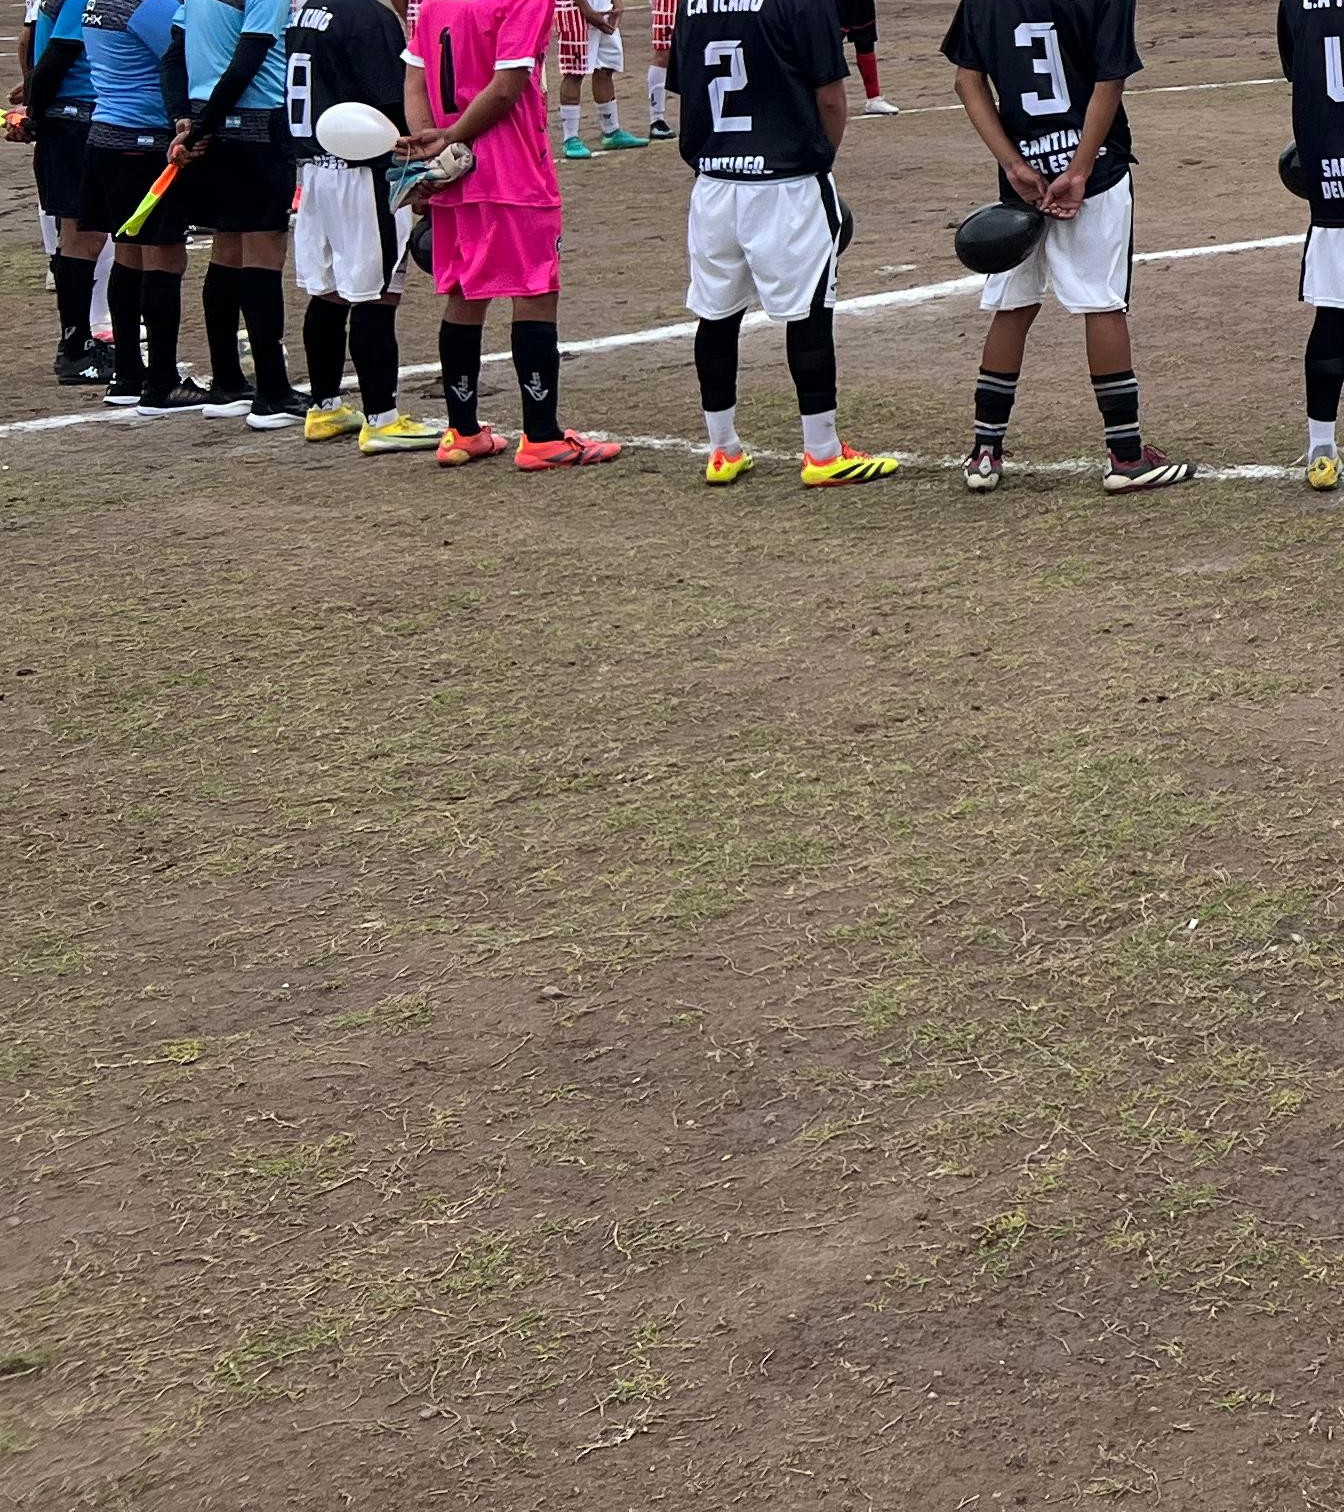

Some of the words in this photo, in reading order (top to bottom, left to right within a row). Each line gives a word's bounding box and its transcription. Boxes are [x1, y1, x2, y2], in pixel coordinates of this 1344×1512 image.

[286, 52, 313, 138] 8
[439, 26, 460, 115] 1
[704, 39, 753, 133] 2
[1014, 21, 1072, 117] 3
[1019, 129, 1082, 157] SANTIA
